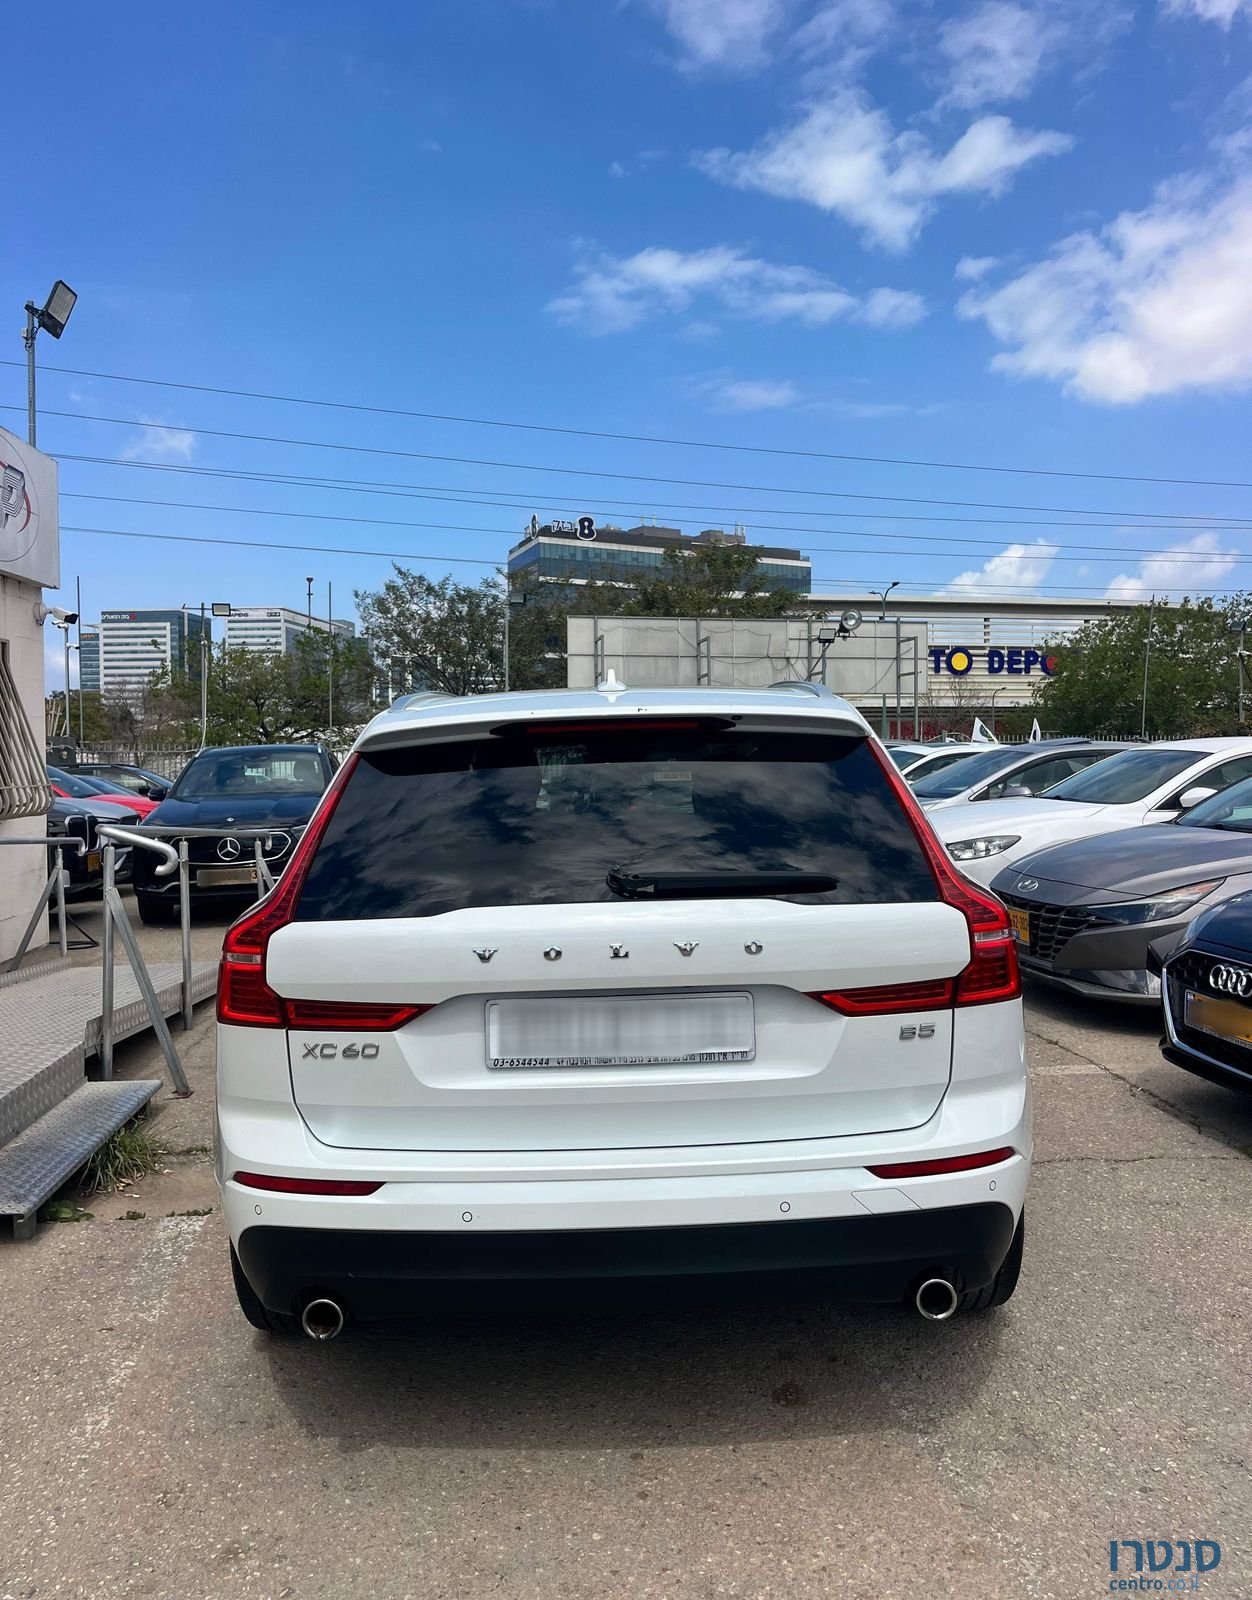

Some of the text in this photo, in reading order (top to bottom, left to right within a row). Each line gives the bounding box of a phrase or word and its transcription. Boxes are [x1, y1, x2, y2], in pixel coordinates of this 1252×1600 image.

[551, 519, 575, 533] בזק
[472, 938, 764, 964] VOLVO
[899, 1022, 936, 1042] B5
[493, 1058, 550, 1067] 03-6544544
